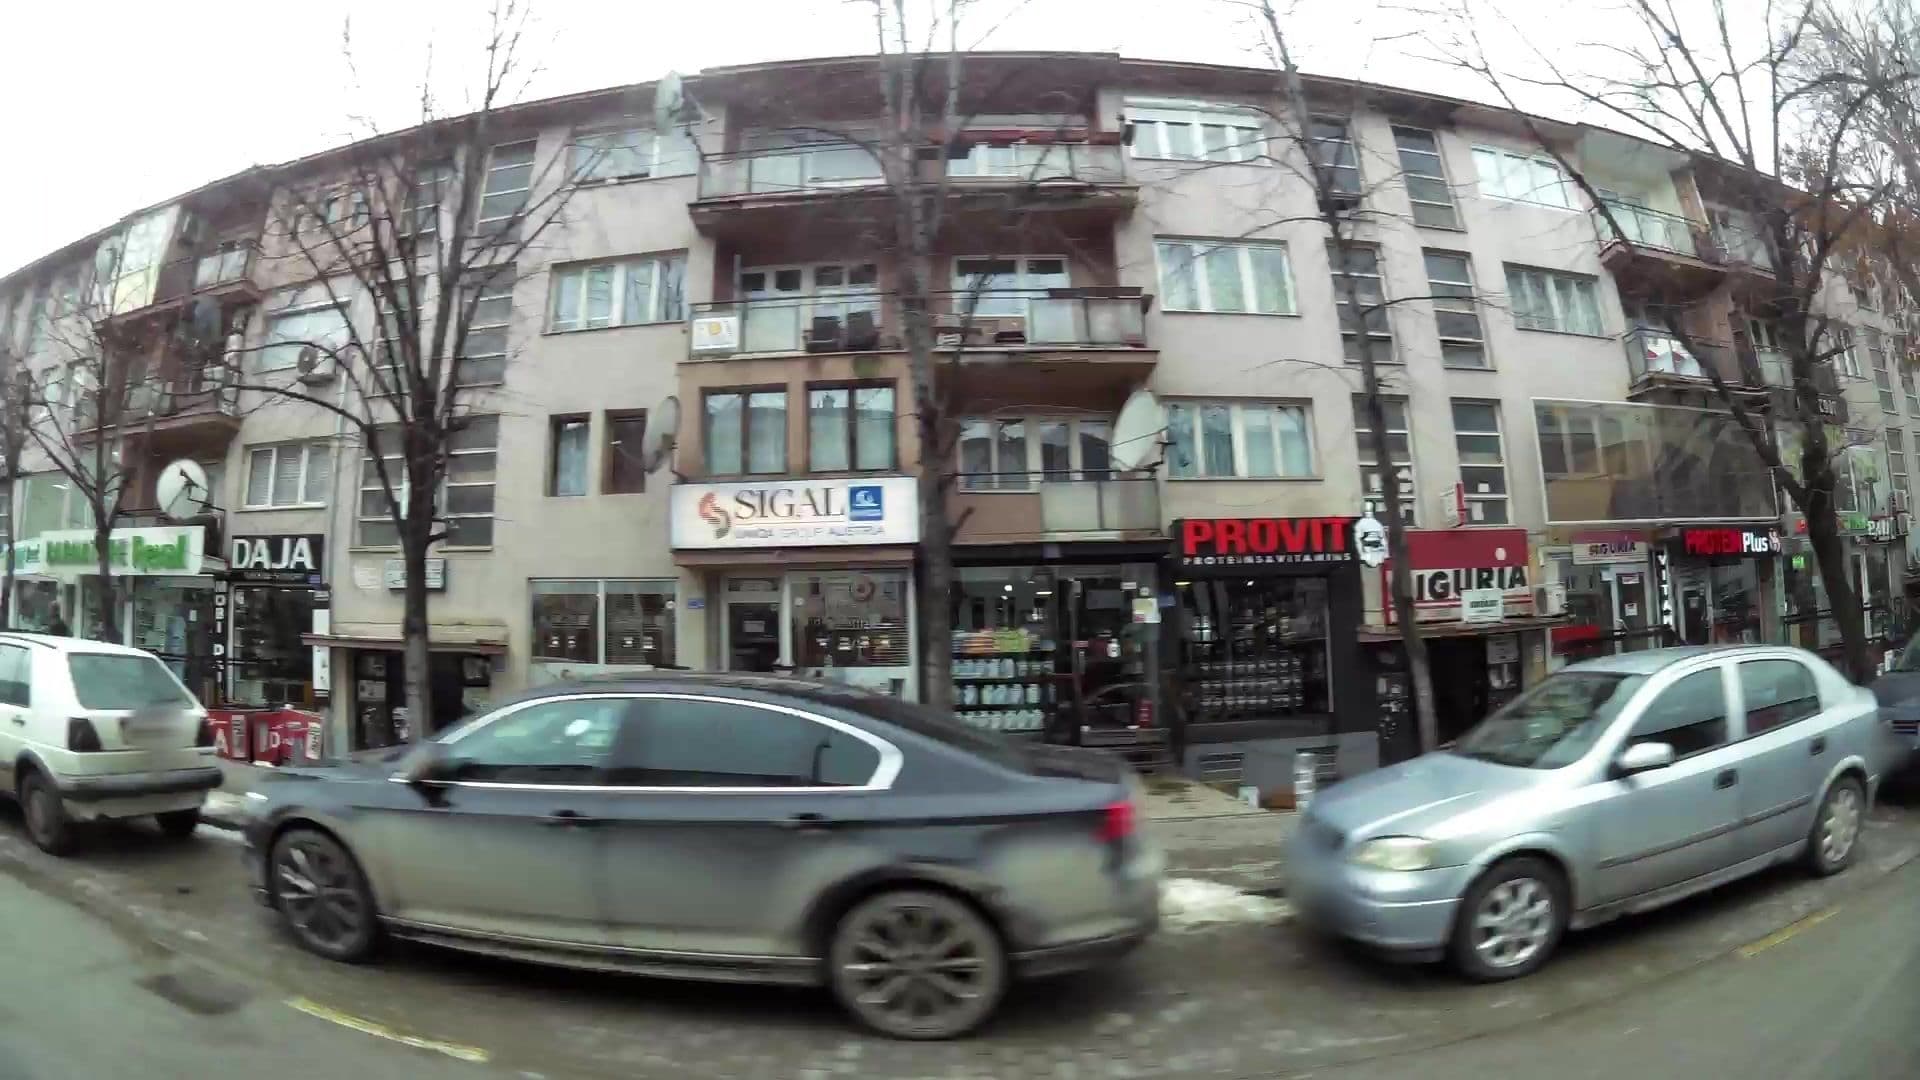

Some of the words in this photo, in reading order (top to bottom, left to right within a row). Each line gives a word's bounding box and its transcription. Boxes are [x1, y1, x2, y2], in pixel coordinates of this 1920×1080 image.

[735, 486, 846, 520] SIGAL
[1183, 517, 1351, 555] PROVIT
[1742, 531, 1769, 553] Plus
[232, 537, 316, 570] DAJA
[1410, 565, 1528, 602] IGURIA
